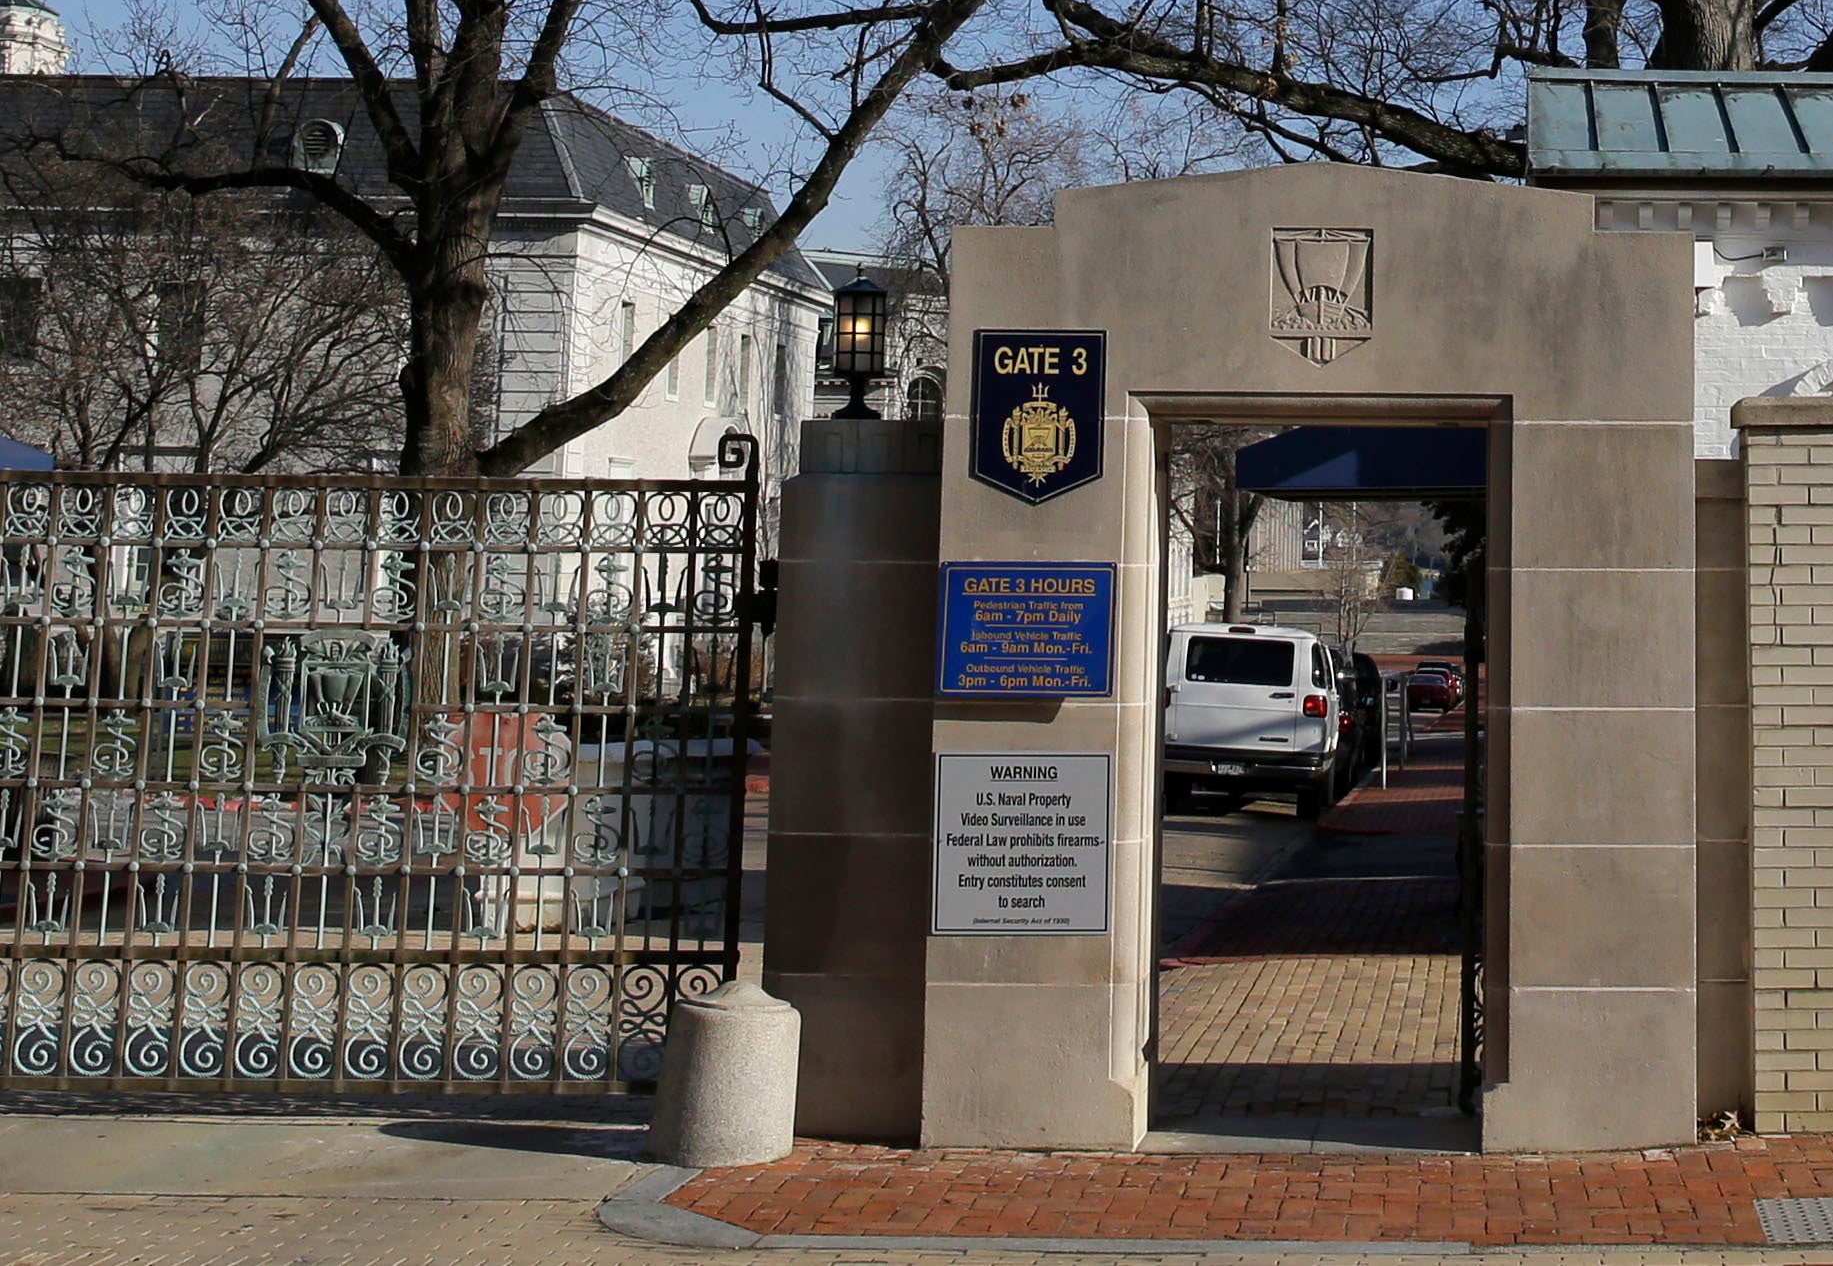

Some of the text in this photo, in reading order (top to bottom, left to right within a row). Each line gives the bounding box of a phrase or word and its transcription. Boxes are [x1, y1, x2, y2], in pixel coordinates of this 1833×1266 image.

[994, 346, 1088, 376] GATE 3
[963, 577, 1096, 594] GATE 3 HOURS
[973, 600, 1085, 611] Pedestrian Traffic from
[975, 610, 1003, 621] 6am
[1015, 610, 1045, 624] 7pm
[1049, 610, 1081, 624] Daily
[971, 630, 1083, 641] Inbound Vehicle Traffic
[960, 641, 988, 653] 6am
[1001, 641, 1029, 654] 9am
[966, 663, 1085, 674] Outbound Vehicle Traffic
[958, 674, 986, 688] 3pm
[999, 675, 1028, 689] 6pm
[990, 766, 1058, 780] WARNING
[976, 793, 1071, 809] U.S. Naval Property
[960, 813, 1086, 827] Video Surveillance in use
[946, 833, 1100, 849] Federal Law prohibits firearms
[967, 854, 1078, 867] without authorization.
[958, 874, 1087, 890] Entry constitutes consent
[998, 895, 1045, 908] to search
[1002, 917, 1029, 925] Security
[1030, 917, 1042, 925] Act
